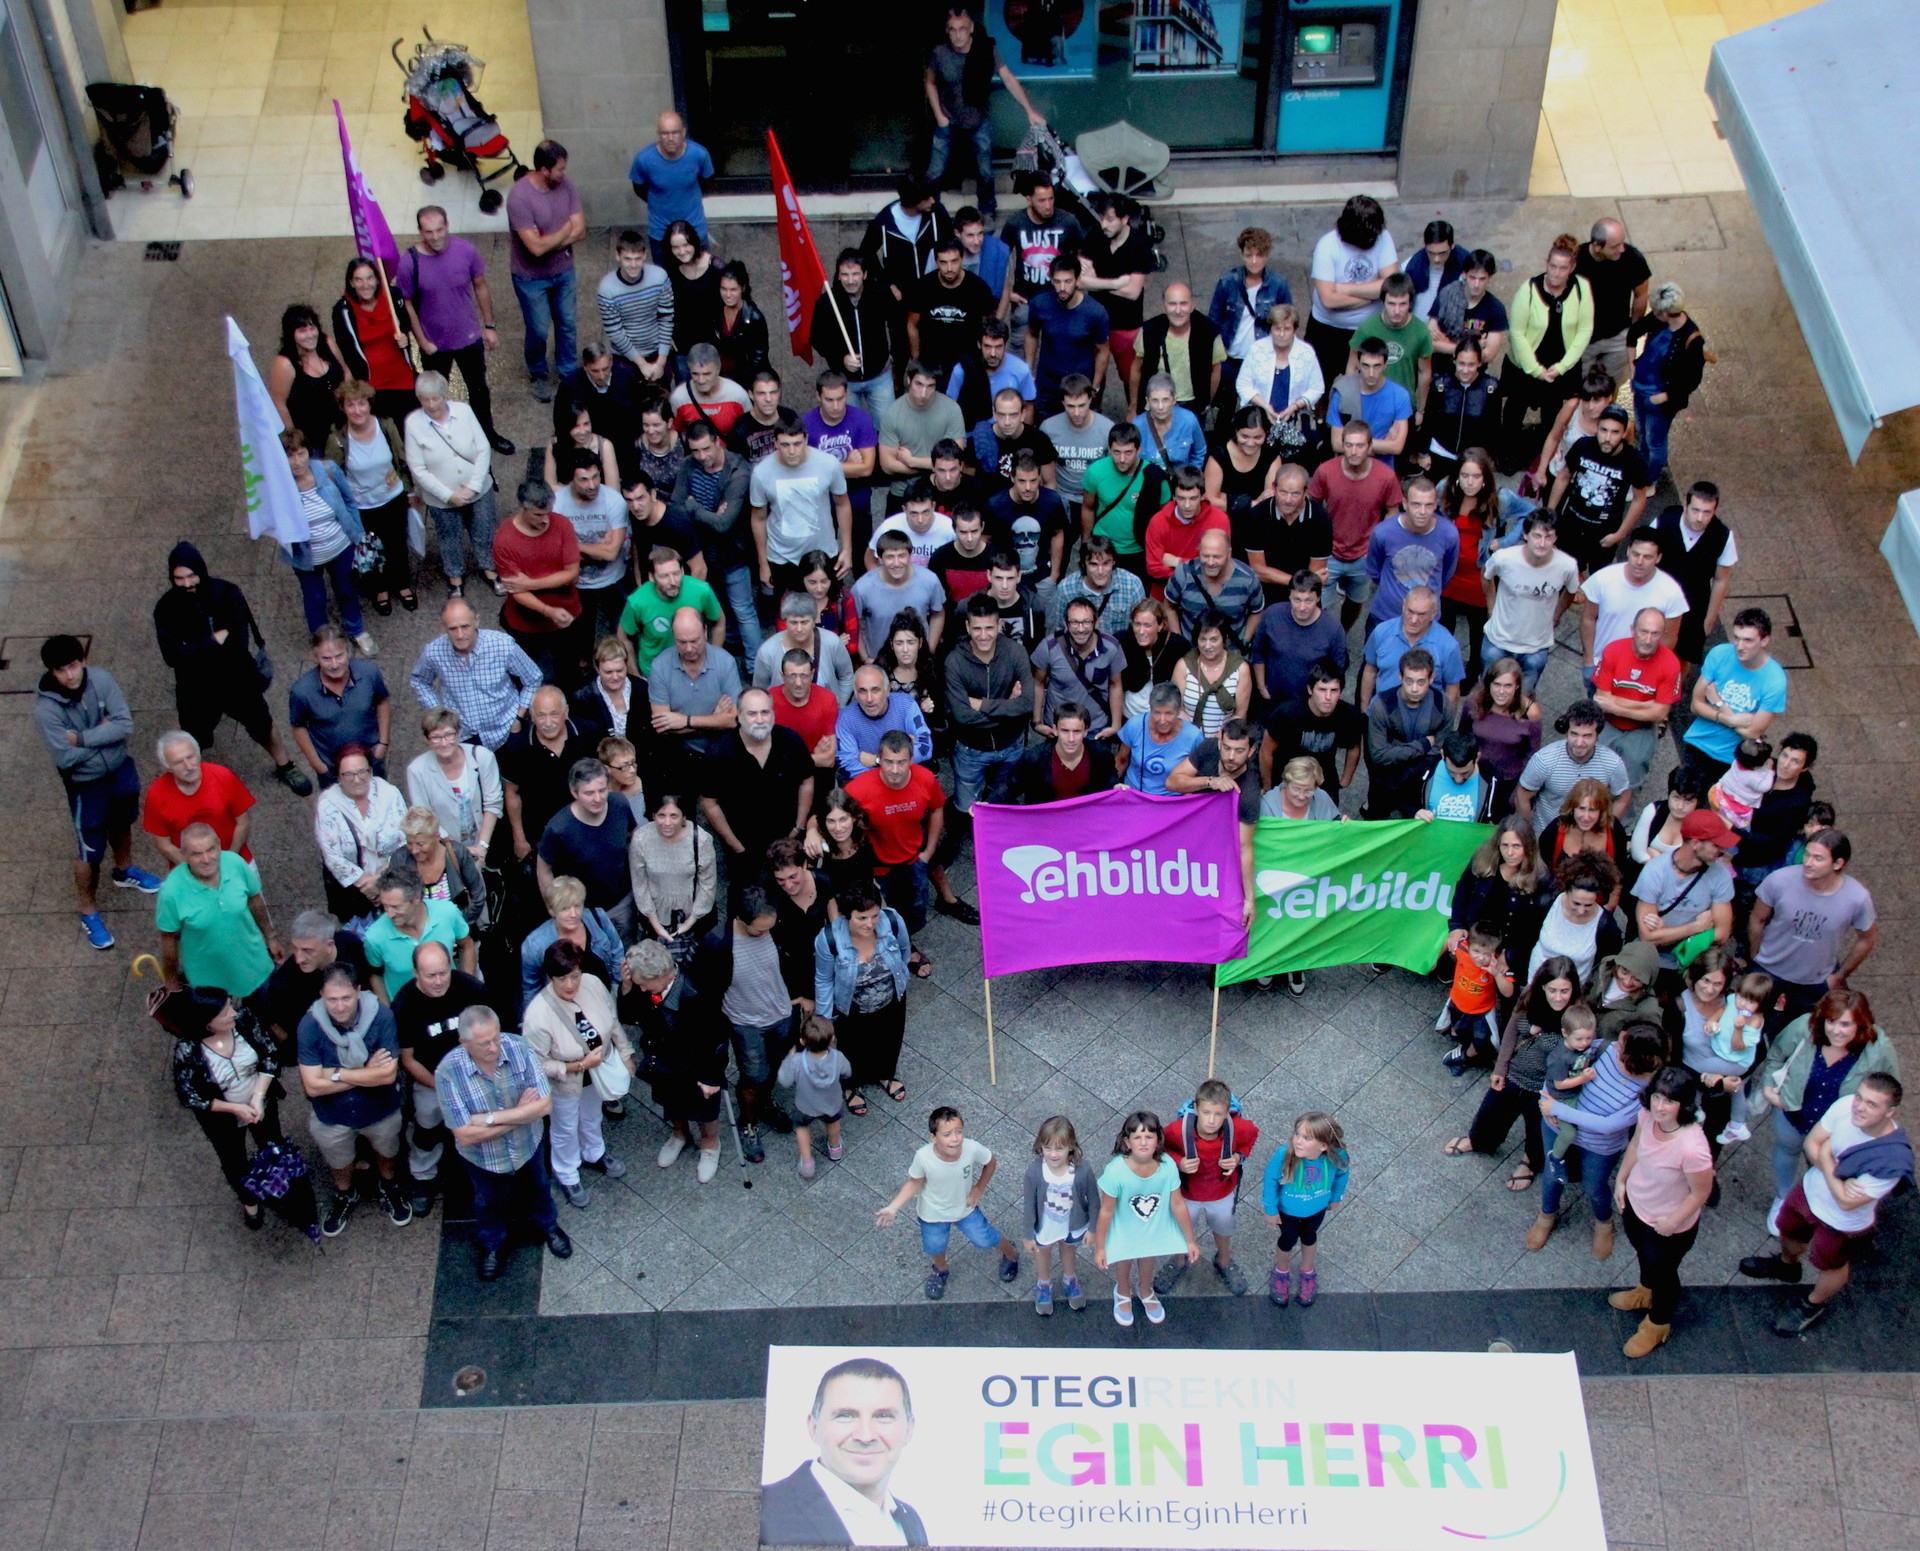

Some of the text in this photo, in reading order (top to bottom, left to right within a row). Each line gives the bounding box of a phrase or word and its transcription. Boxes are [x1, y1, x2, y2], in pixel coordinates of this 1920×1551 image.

[1020, 229, 1064, 249] LUST
[1023, 262, 1051, 284] SUR
[1056, 446, 1104, 459] CK&JONES
[1439, 793, 1472, 806] GORA
[1035, 848, 1219, 901] ehbildu
[984, 1421, 1508, 1489] EGIN HERRI
[982, 1499, 1308, 1530] #OtegirekinEginHerri
